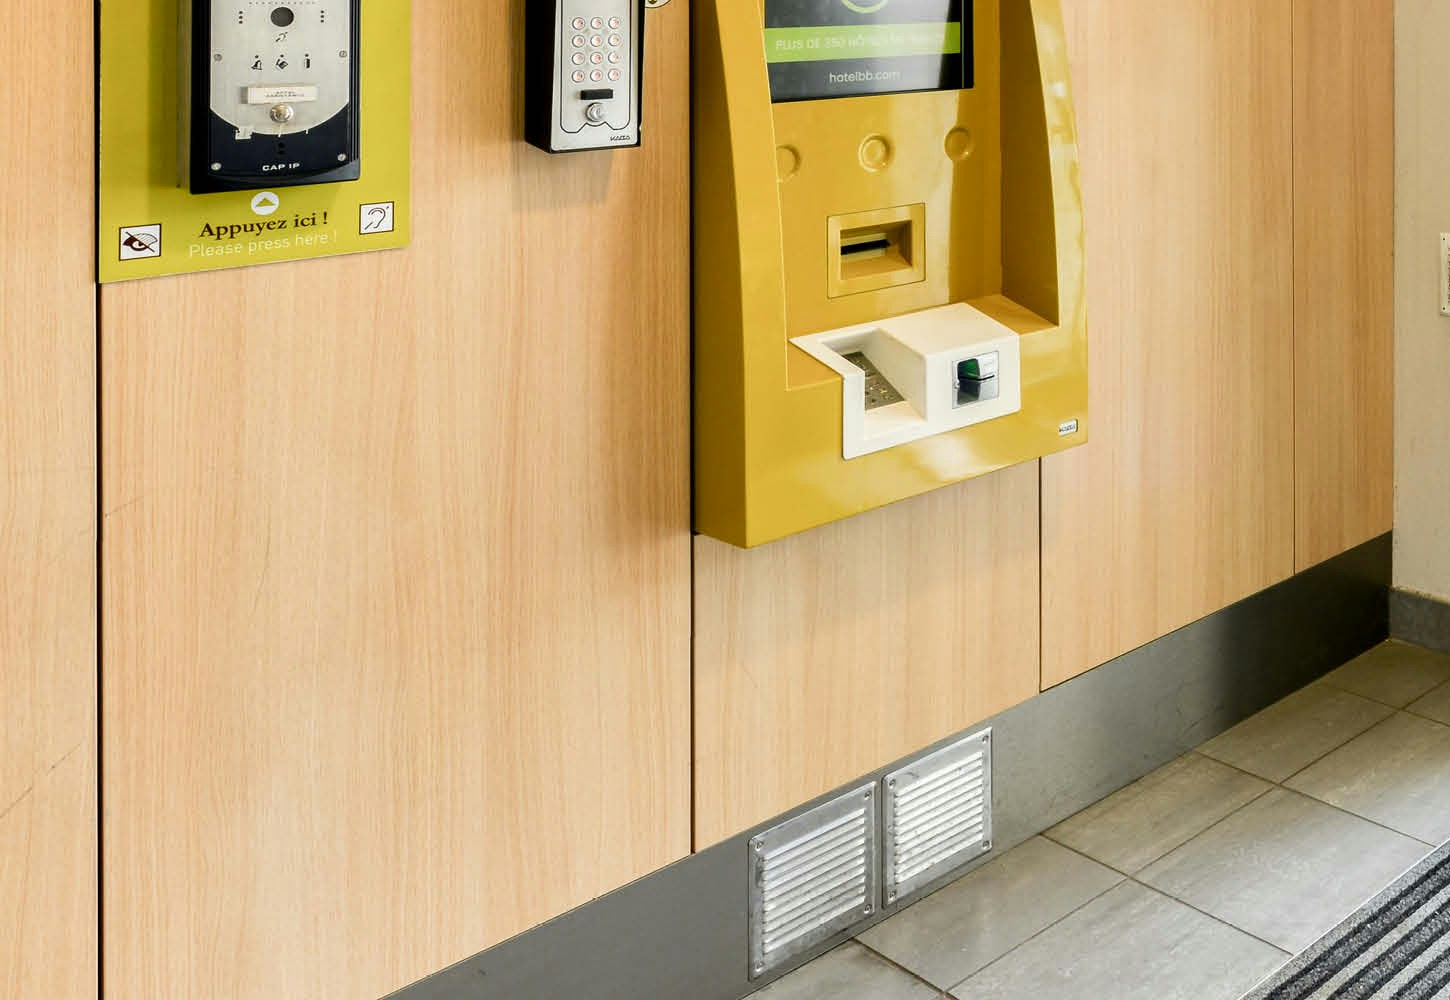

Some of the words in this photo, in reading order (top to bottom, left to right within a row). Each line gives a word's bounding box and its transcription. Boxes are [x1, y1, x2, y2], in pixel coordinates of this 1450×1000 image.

[829, 69, 900, 84] hotelbb.com
[262, 163, 285, 171] CAP
[200, 219, 287, 240] Appuyez
[294, 213, 317, 228] ici
[323, 211, 328, 225] !
[189, 242, 243, 257] Please
[248, 236, 290, 256] press
[295, 231, 329, 247] here
